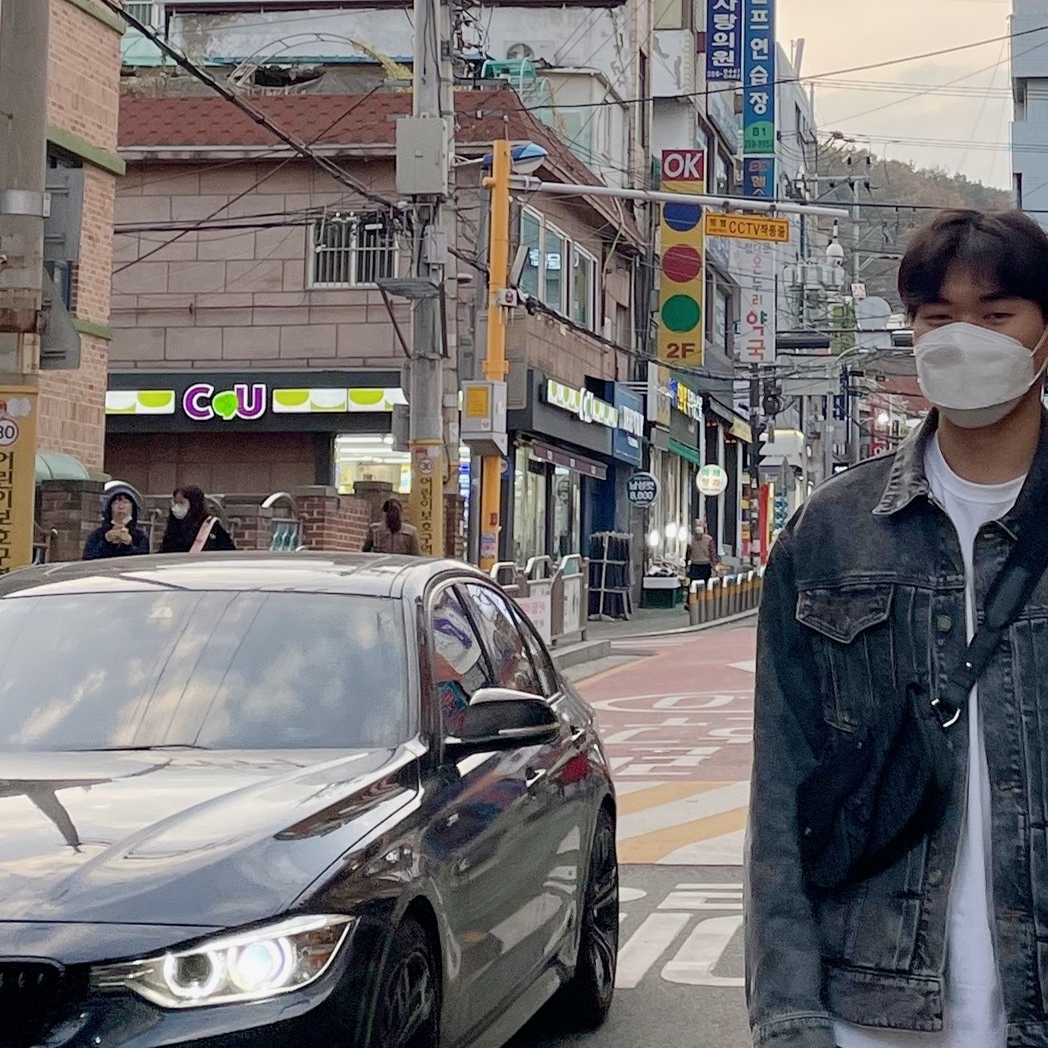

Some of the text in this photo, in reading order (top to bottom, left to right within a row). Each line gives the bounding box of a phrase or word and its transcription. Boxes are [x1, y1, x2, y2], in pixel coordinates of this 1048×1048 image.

[749, 0, 769, 115] 프연습장
[663, 152, 702, 178] OK
[666, 343, 696, 359] 2F
